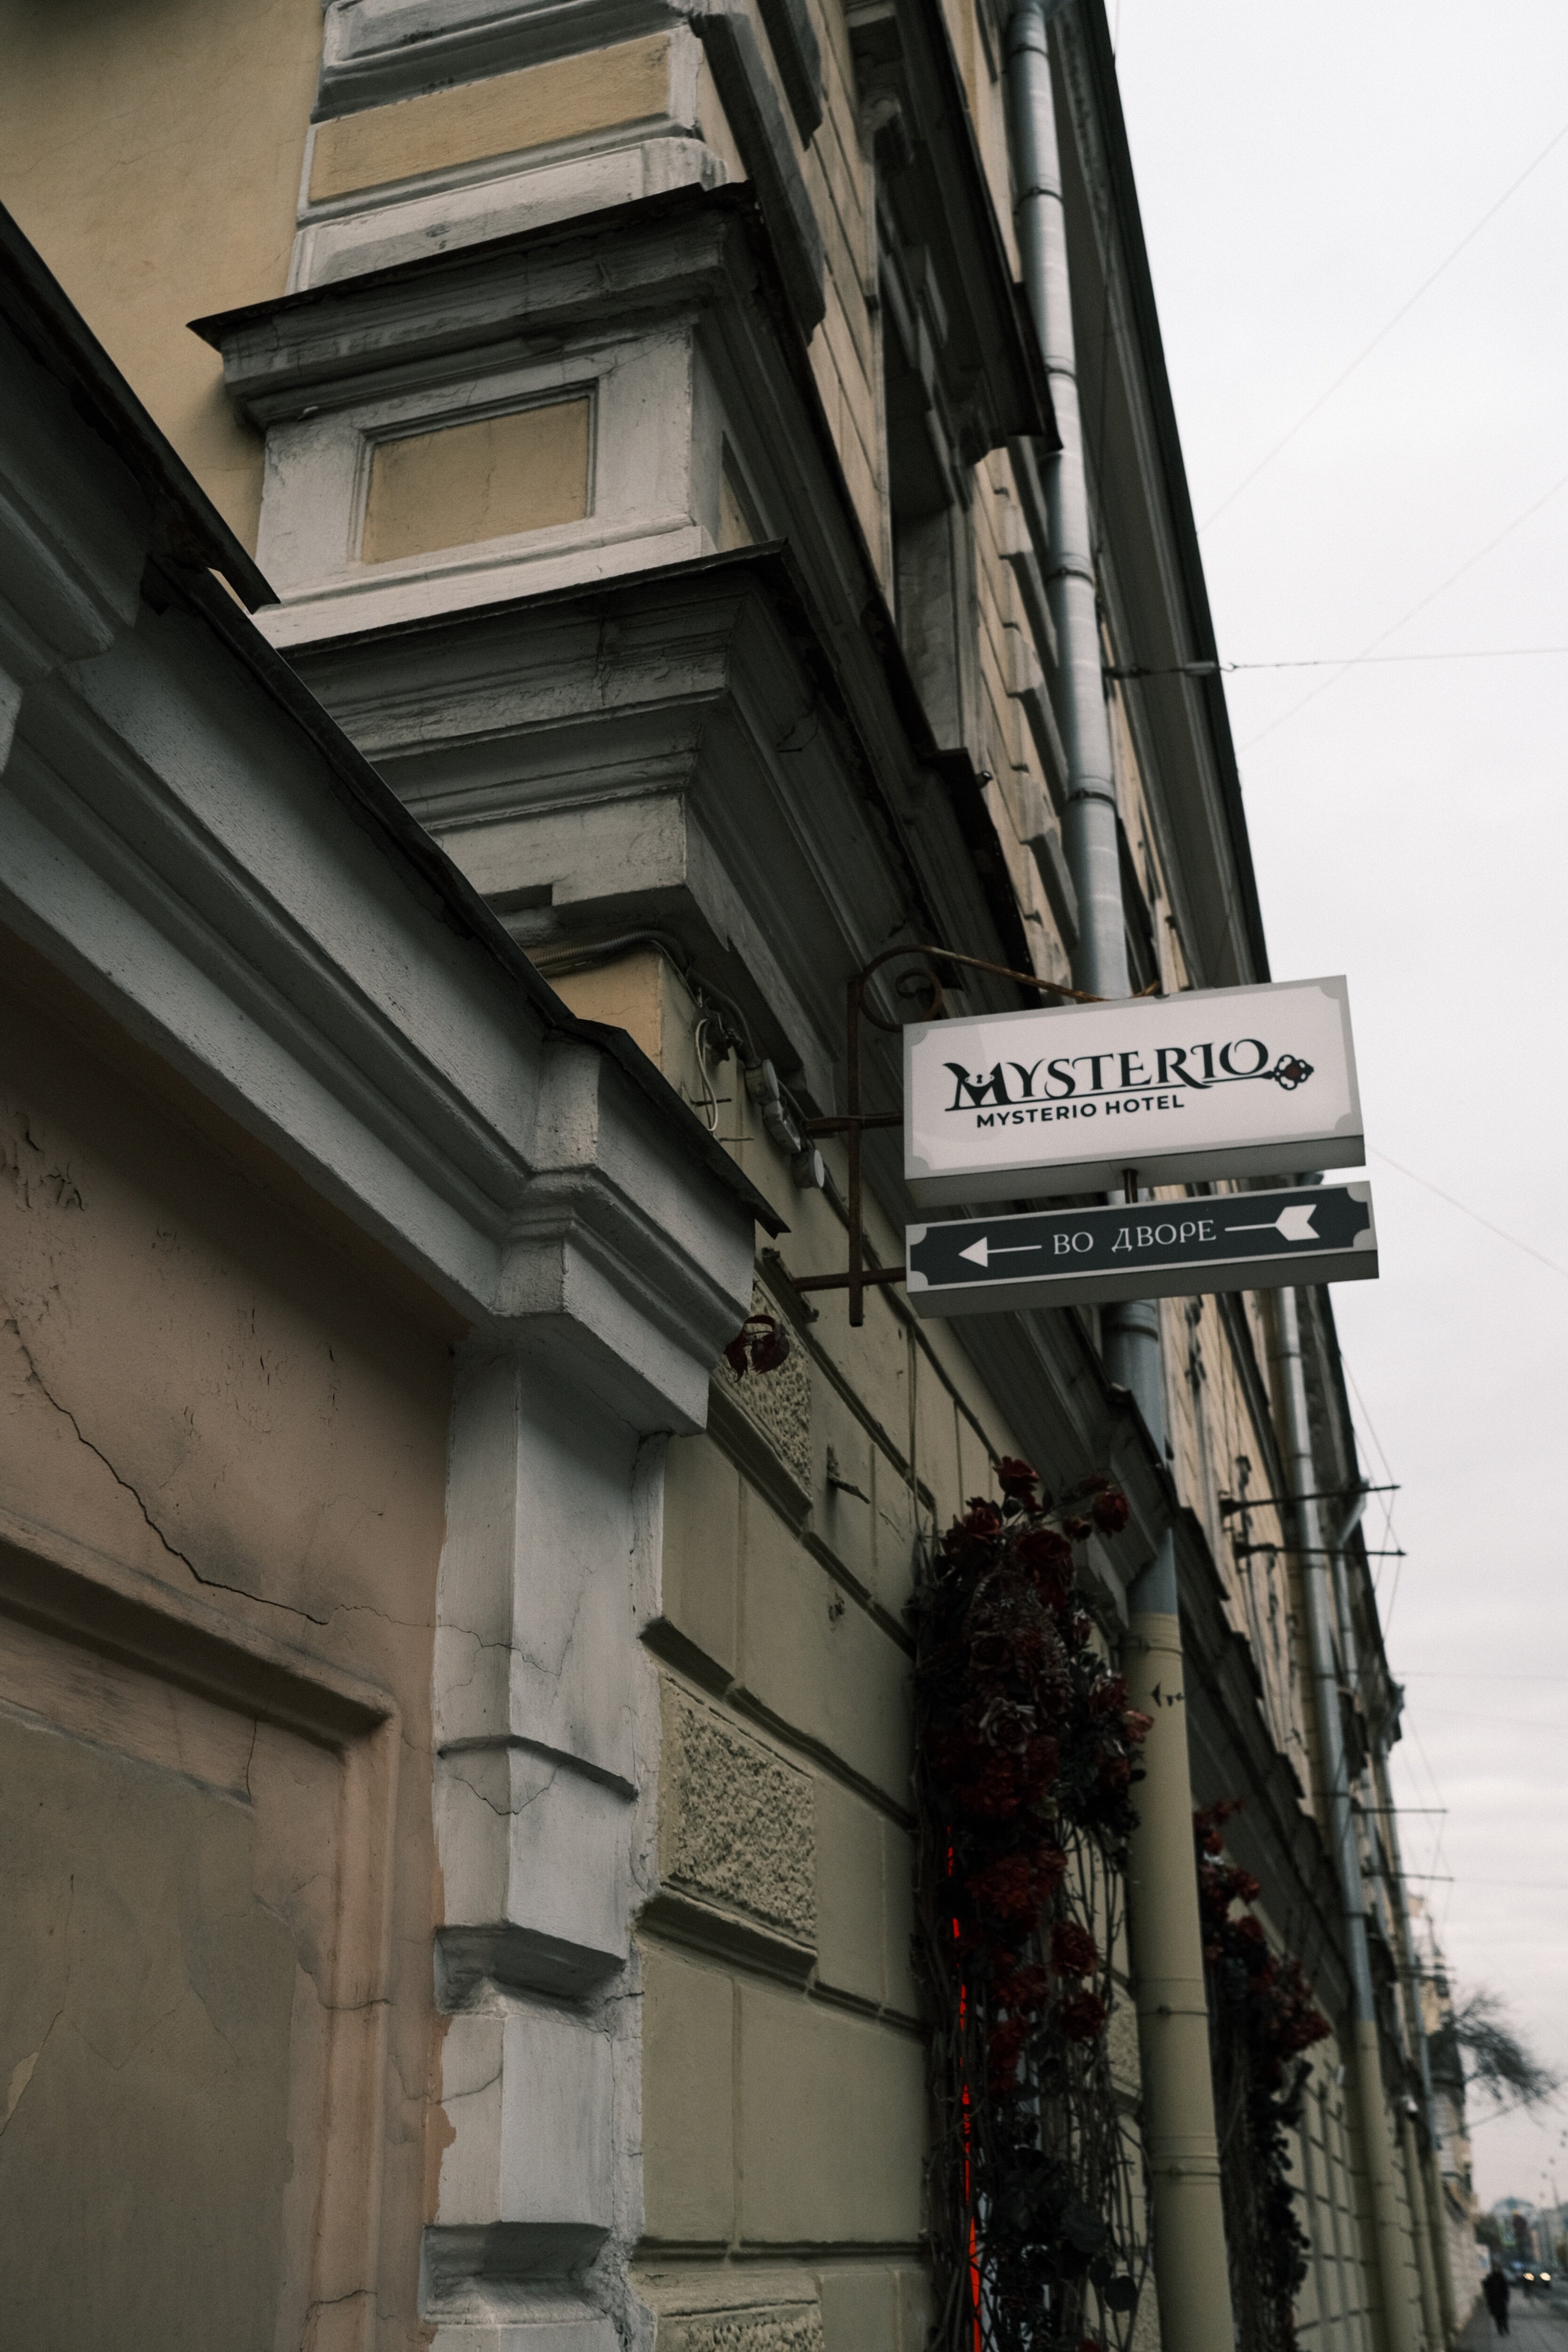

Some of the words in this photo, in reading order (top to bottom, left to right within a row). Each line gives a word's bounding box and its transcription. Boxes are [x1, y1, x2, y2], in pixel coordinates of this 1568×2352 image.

[942, 1039, 1269, 1112] MYSTERIO
[977, 1103, 1097, 1128] MYSTERIO
[1106, 1095, 1185, 1115] HOTEL
[1053, 1232, 1094, 1255] ВО
[1111, 1219, 1217, 1253] ДВОРЕ
